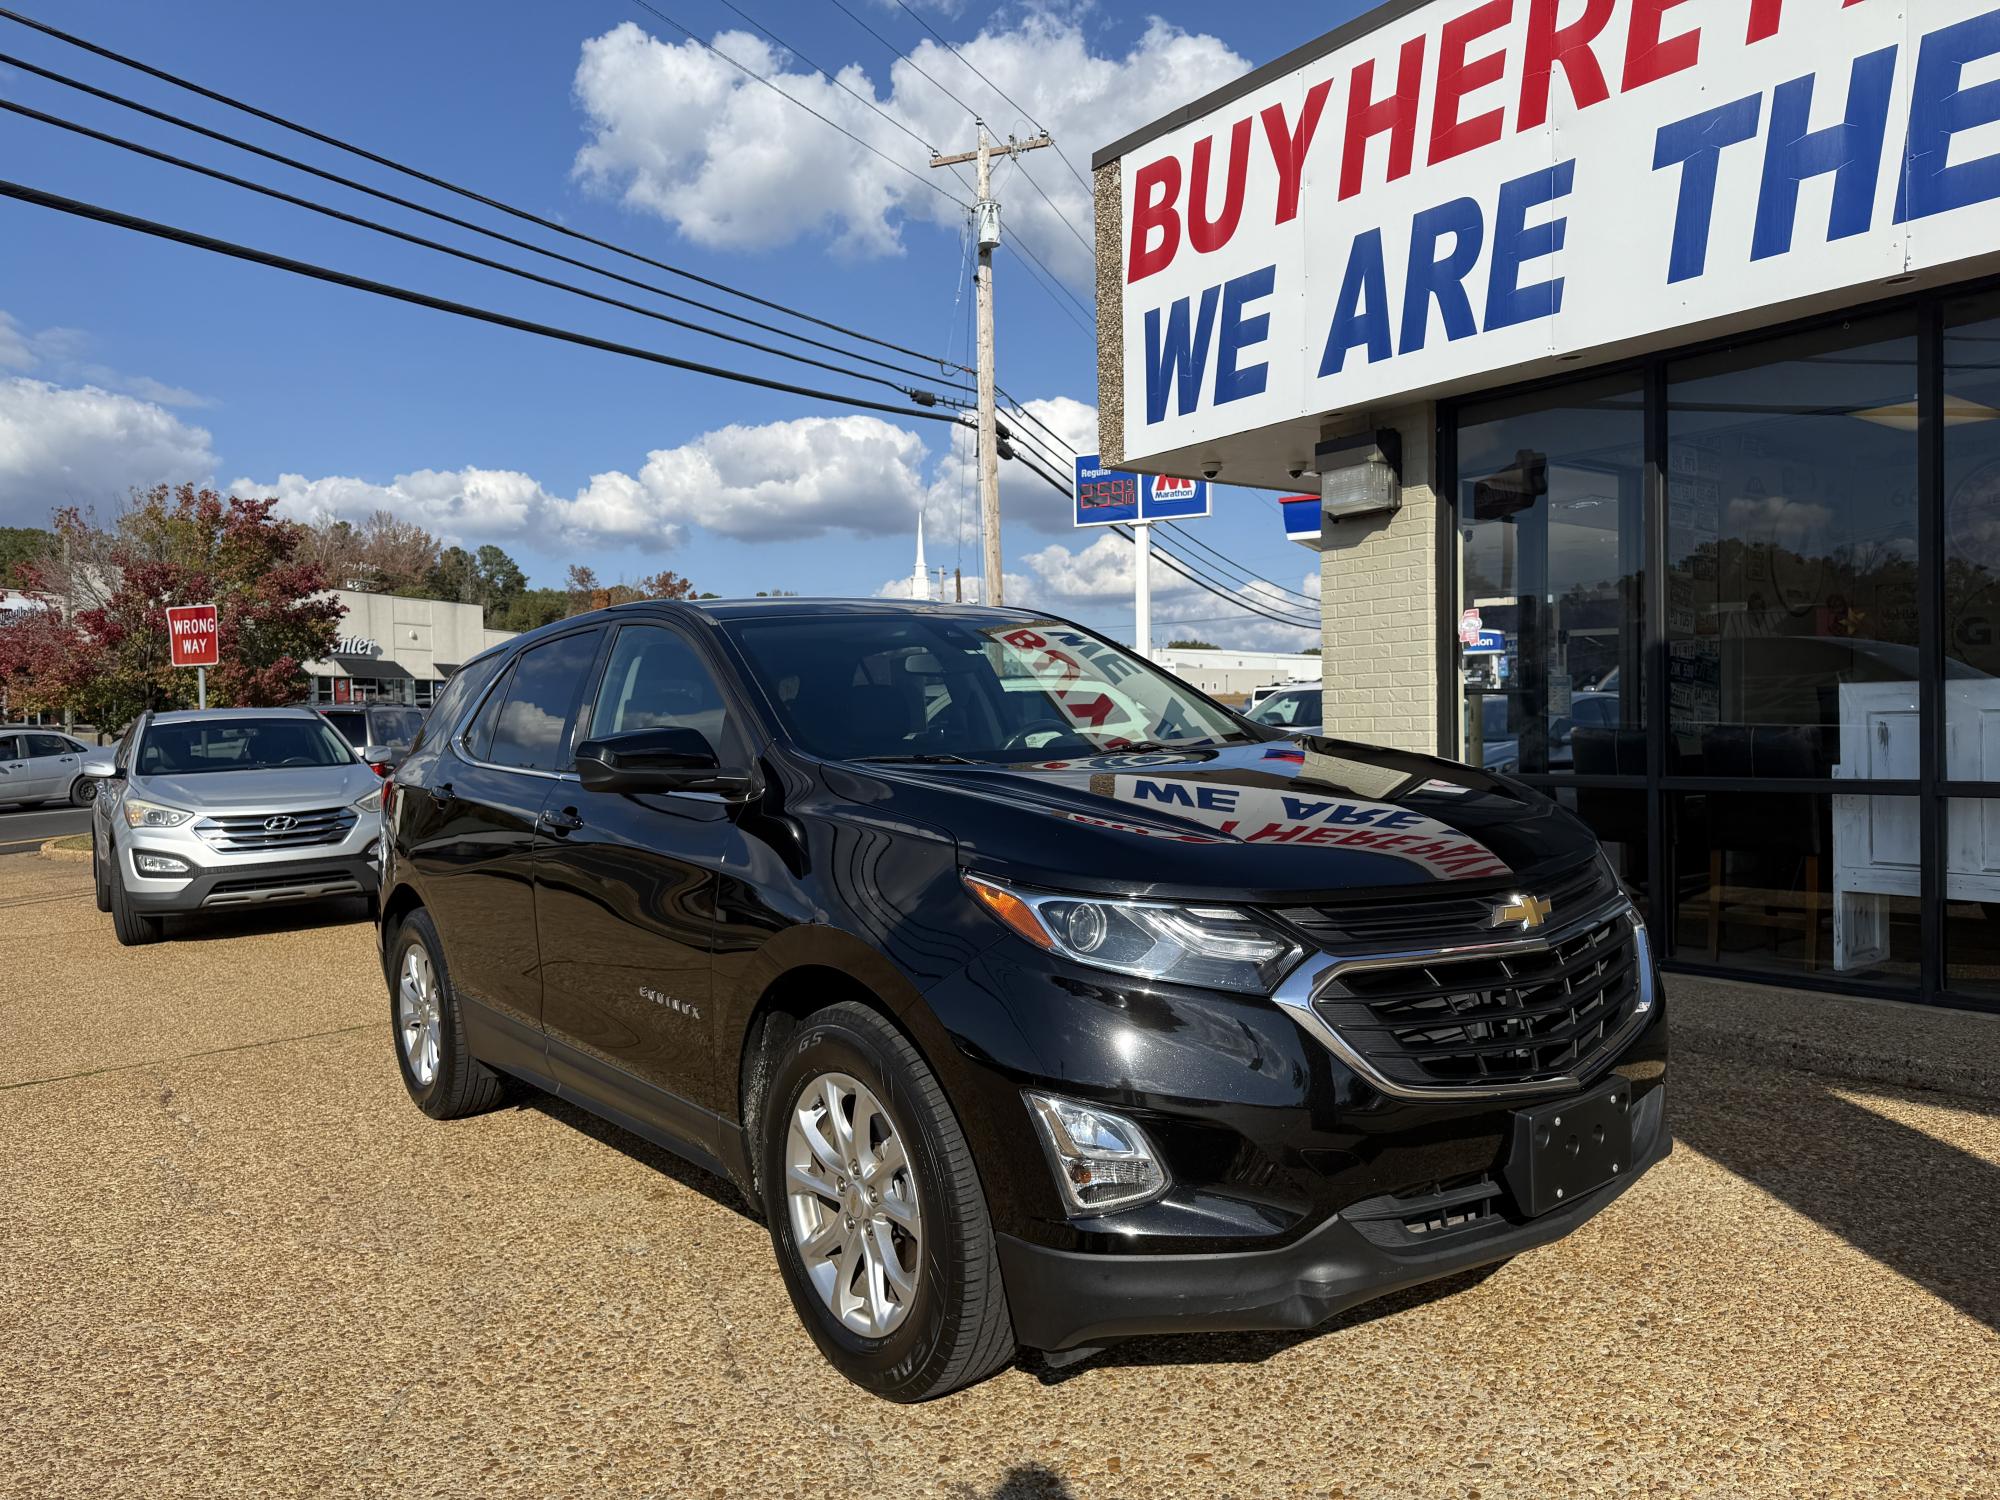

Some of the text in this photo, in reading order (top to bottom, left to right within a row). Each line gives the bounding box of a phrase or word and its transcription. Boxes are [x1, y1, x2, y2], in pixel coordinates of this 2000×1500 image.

[1145, 11, 2000, 425] WE ARE THE
[1154, 489, 1193, 499] Marathon
[173, 615, 216, 635] WRONG
[183, 638, 207, 655] WAY
[329, 635, 377, 655] enter
[638, 985, 702, 1020] EQUINOX
